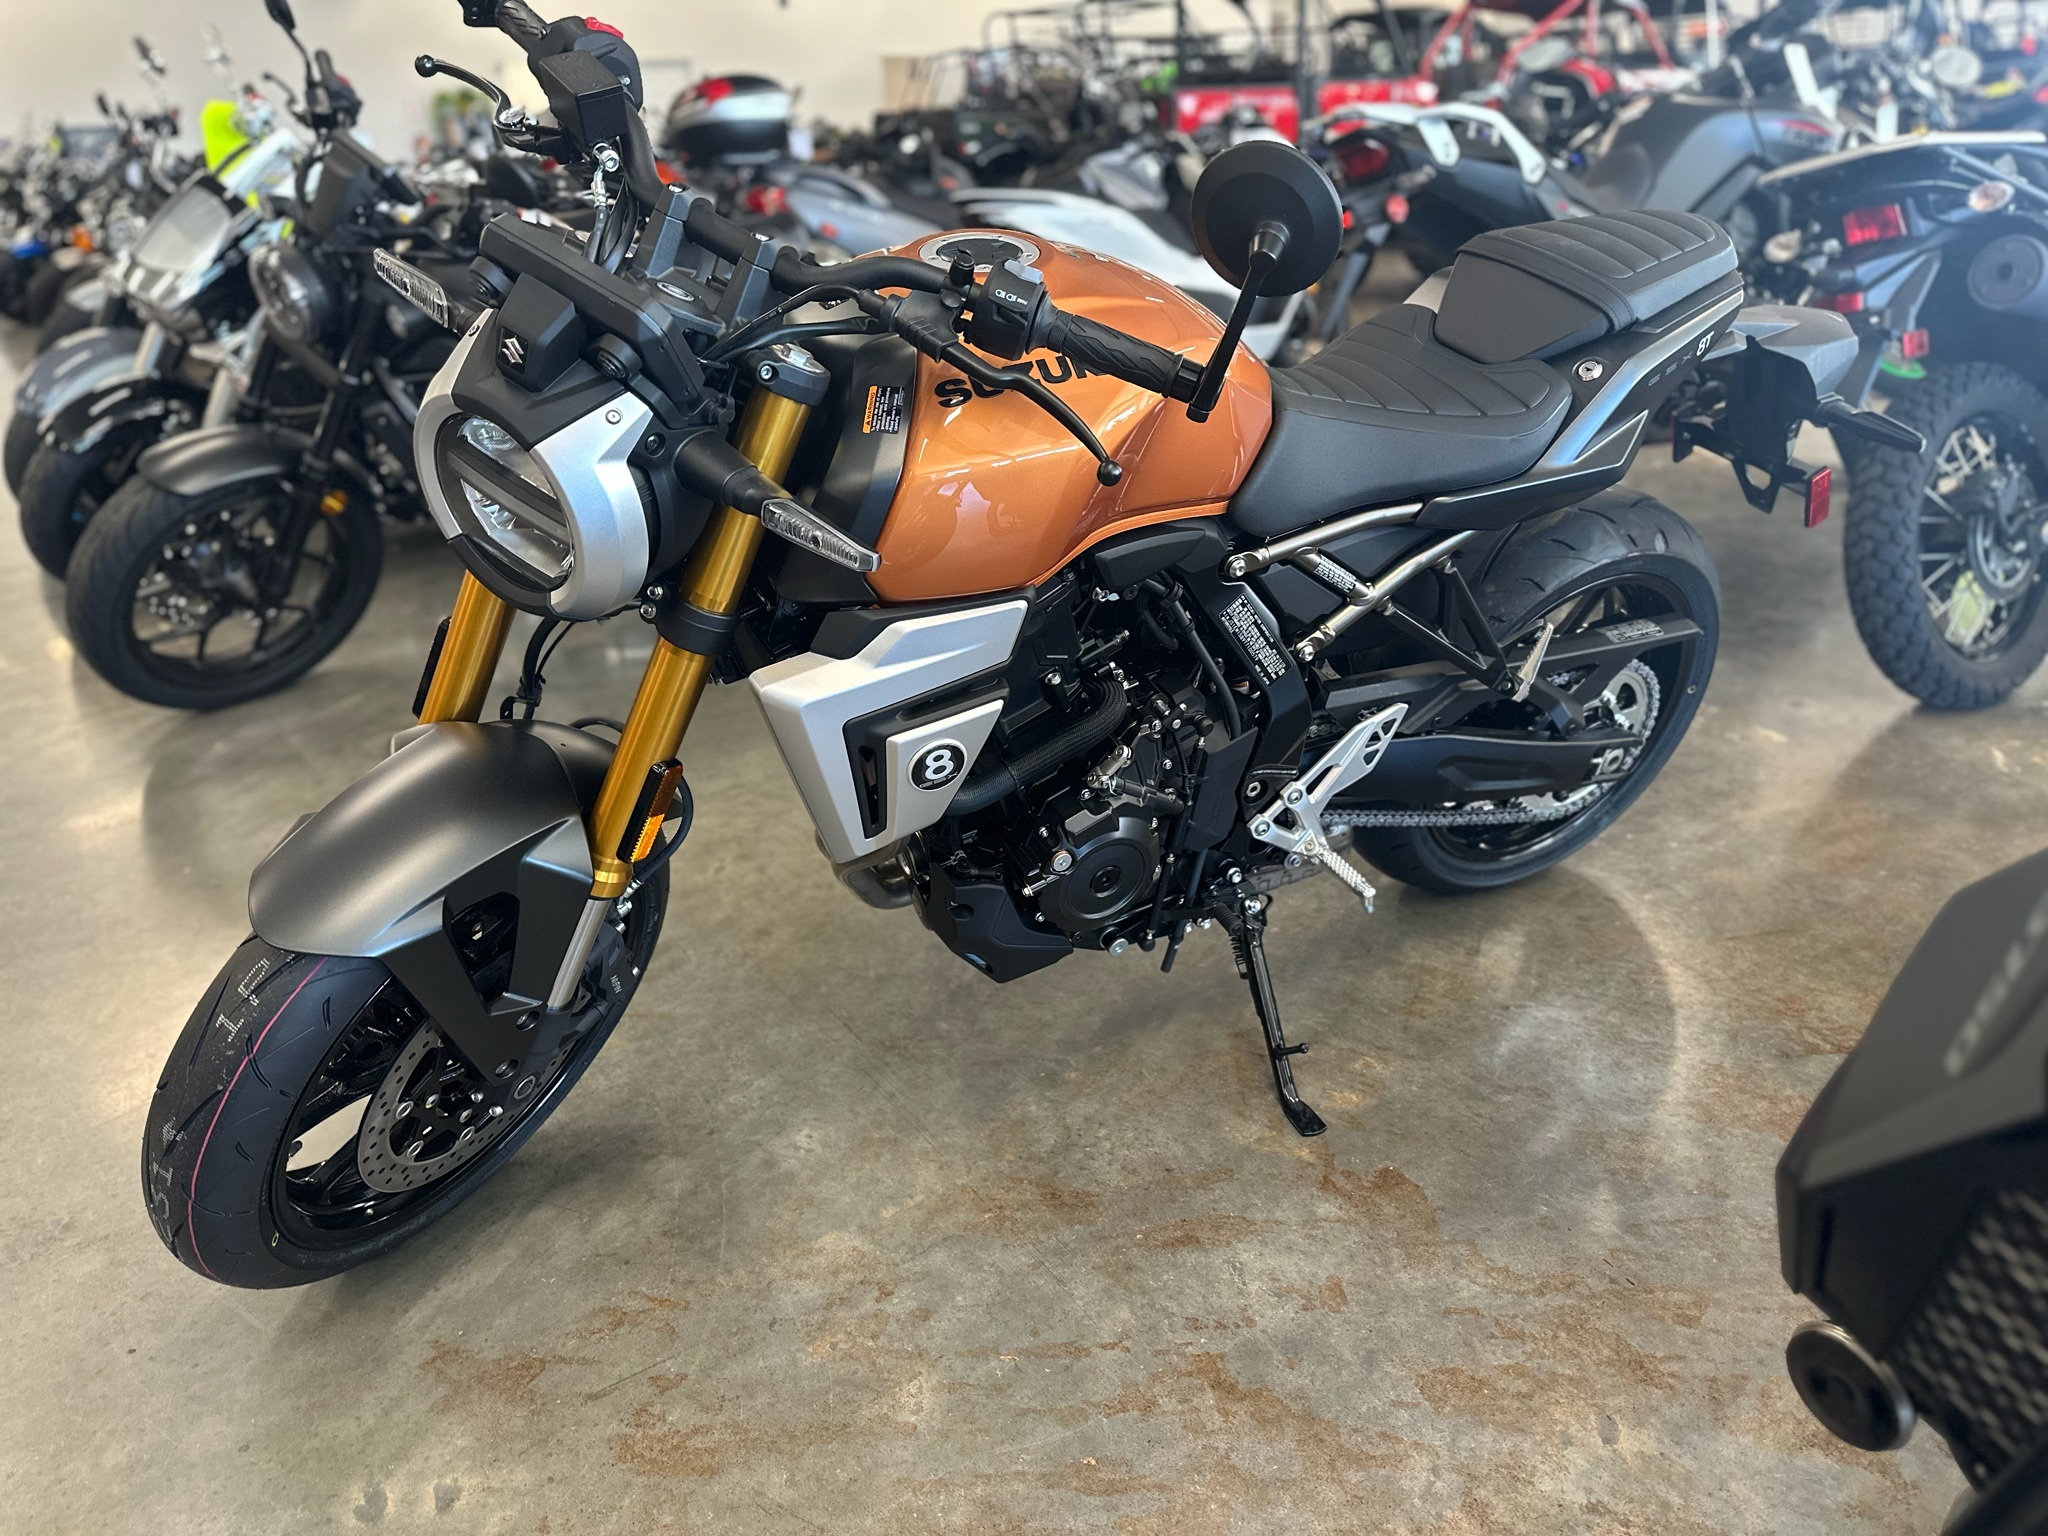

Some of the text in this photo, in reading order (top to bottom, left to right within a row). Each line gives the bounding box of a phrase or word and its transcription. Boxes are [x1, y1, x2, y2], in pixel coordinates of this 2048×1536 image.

[1696, 330, 1715, 356] 8T
[866, 392, 875, 419] WARNING
[925, 749, 954, 780] 8
